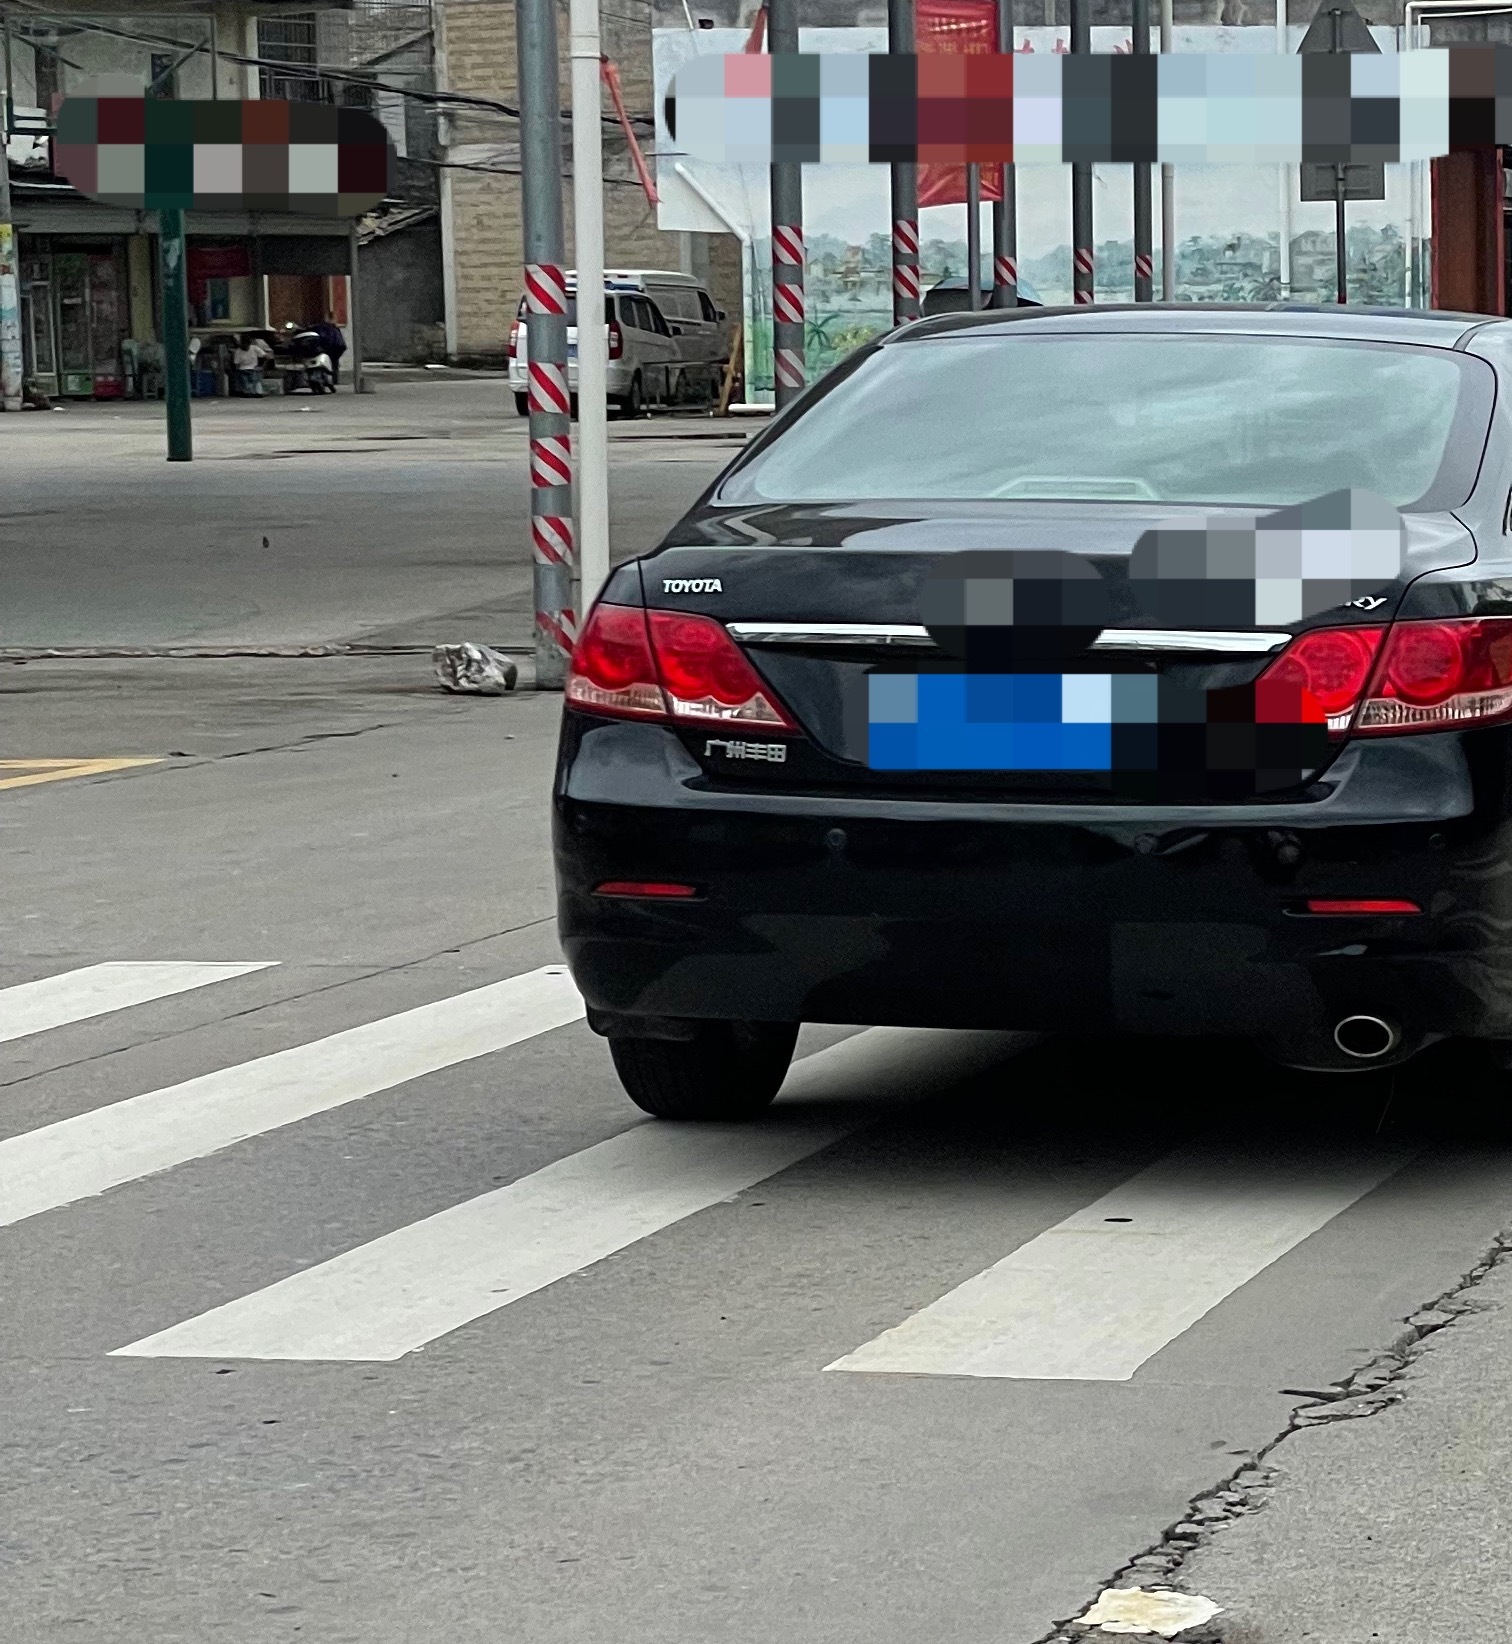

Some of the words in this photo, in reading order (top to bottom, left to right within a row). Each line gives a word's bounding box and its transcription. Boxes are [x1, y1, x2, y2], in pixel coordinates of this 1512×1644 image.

[662, 579, 723, 593] TOYOTA
[703, 739, 787, 762] 广州丰田
